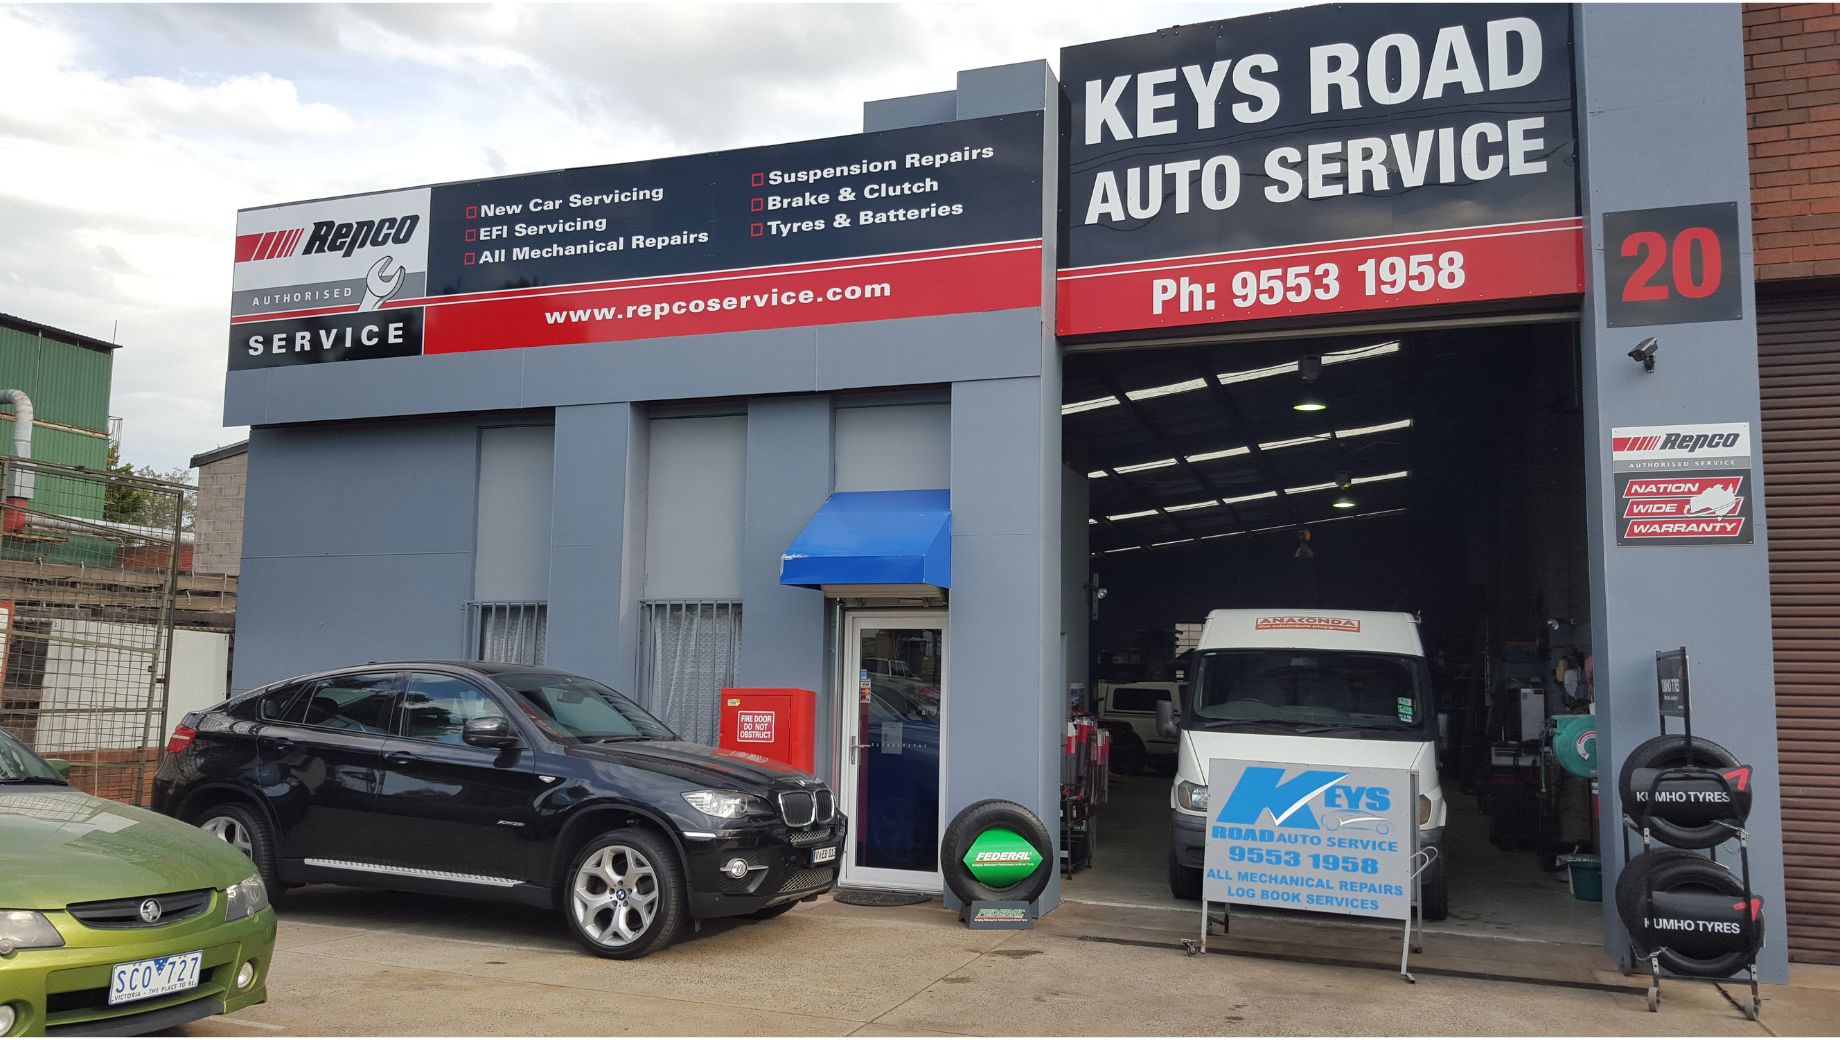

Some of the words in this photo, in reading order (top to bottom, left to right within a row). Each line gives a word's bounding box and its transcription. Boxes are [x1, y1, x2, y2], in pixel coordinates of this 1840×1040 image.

[1084, 54, 1280, 145] KEYS
[1309, 17, 1543, 114] ROAD
[768, 159, 897, 185] Suspension
[905, 146, 994, 169] Repairs
[1084, 155, 1240, 225] AUTO
[1263, 116, 1548, 203] SERVICE
[480, 202, 523, 218] New
[528, 197, 563, 212] Car
[569, 187, 664, 208] Servicing
[767, 191, 830, 210] Brake
[838, 187, 856, 202] &
[864, 178, 938, 200] Clutch
[479, 225, 509, 241] EFI
[513, 216, 607, 238] Servicing
[767, 216, 825, 238] Tyres
[833, 213, 851, 228] &
[859, 202, 963, 226] Batteries
[302, 213, 420, 258] Repco
[479, 247, 506, 264] All
[511, 237, 624, 262] Mechanical
[631, 230, 709, 252] Repairs
[1620, 226, 1722, 302] 20
[252, 287, 353, 306] AUTHORISED
[1152, 278, 1215, 315] Ph:
[1232, 262, 1339, 308] 9553
[1357, 251, 1466, 297] 1958
[545, 281, 891, 326] www.repcoservice.com
[248, 322, 404, 357] SERVICE
[1660, 432, 1739, 452] Repco
[1694, 459, 1736, 467] SERVICE
[1631, 482, 1699, 494] NATION
[1632, 503, 1677, 513] WIDE
[1632, 522, 1738, 535] WARRANTY
[1261, 618, 1355, 626] ANACONDA
[754, 715, 772, 723] DOOR
[755, 723, 768, 731] NOT
[740, 731, 771, 739] OBSTRUCT
[1216, 766, 1390, 830] KEYS
[1688, 791, 1730, 803] TYRES
[1212, 825, 1276, 843] ROAD
[1276, 834, 1322, 847] AUTO
[1327, 837, 1399, 852] SERVICE
[976, 852, 1031, 860] FEDERAL
[1228, 846, 1302, 868] 9553
[1308, 853, 1379, 875] 1958
[1206, 868, 1233, 881] ALL
[1237, 870, 1335, 890] MECHANICAL
[1339, 880, 1403, 896] REPAIRS
[1227, 886, 1256, 899] LOG
[1260, 889, 1303, 904] BOOK
[1307, 894, 1379, 911] SERVICES
[1697, 921, 1740, 934] TYRES
[168, 957, 199, 984] 727
[114, 992, 141, 1001] VICTORIA
[161, 983, 177, 992] PLACE
